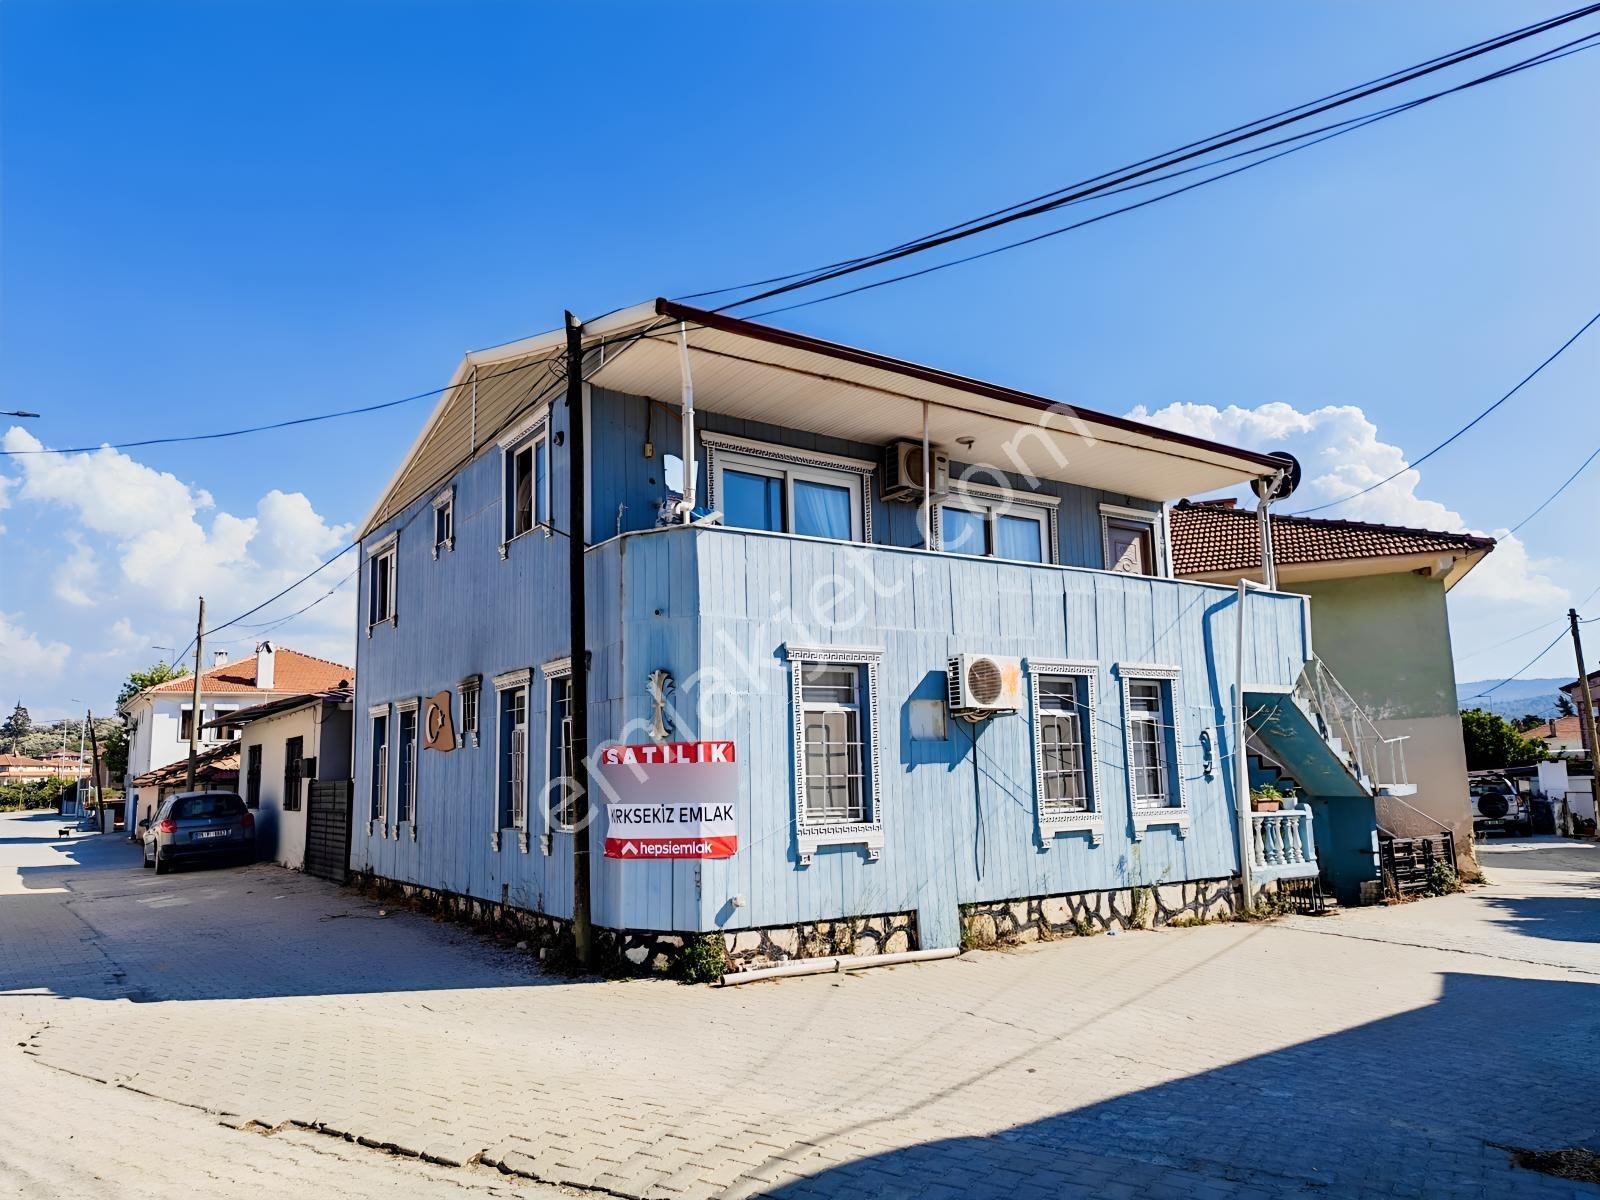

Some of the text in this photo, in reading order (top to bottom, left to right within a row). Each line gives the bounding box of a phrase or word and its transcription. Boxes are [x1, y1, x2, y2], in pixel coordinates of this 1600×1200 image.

[606, 744, 728, 764] SATILIK
[680, 805, 733, 823] EMLAK
[640, 841, 713, 856] hepsiemlak
